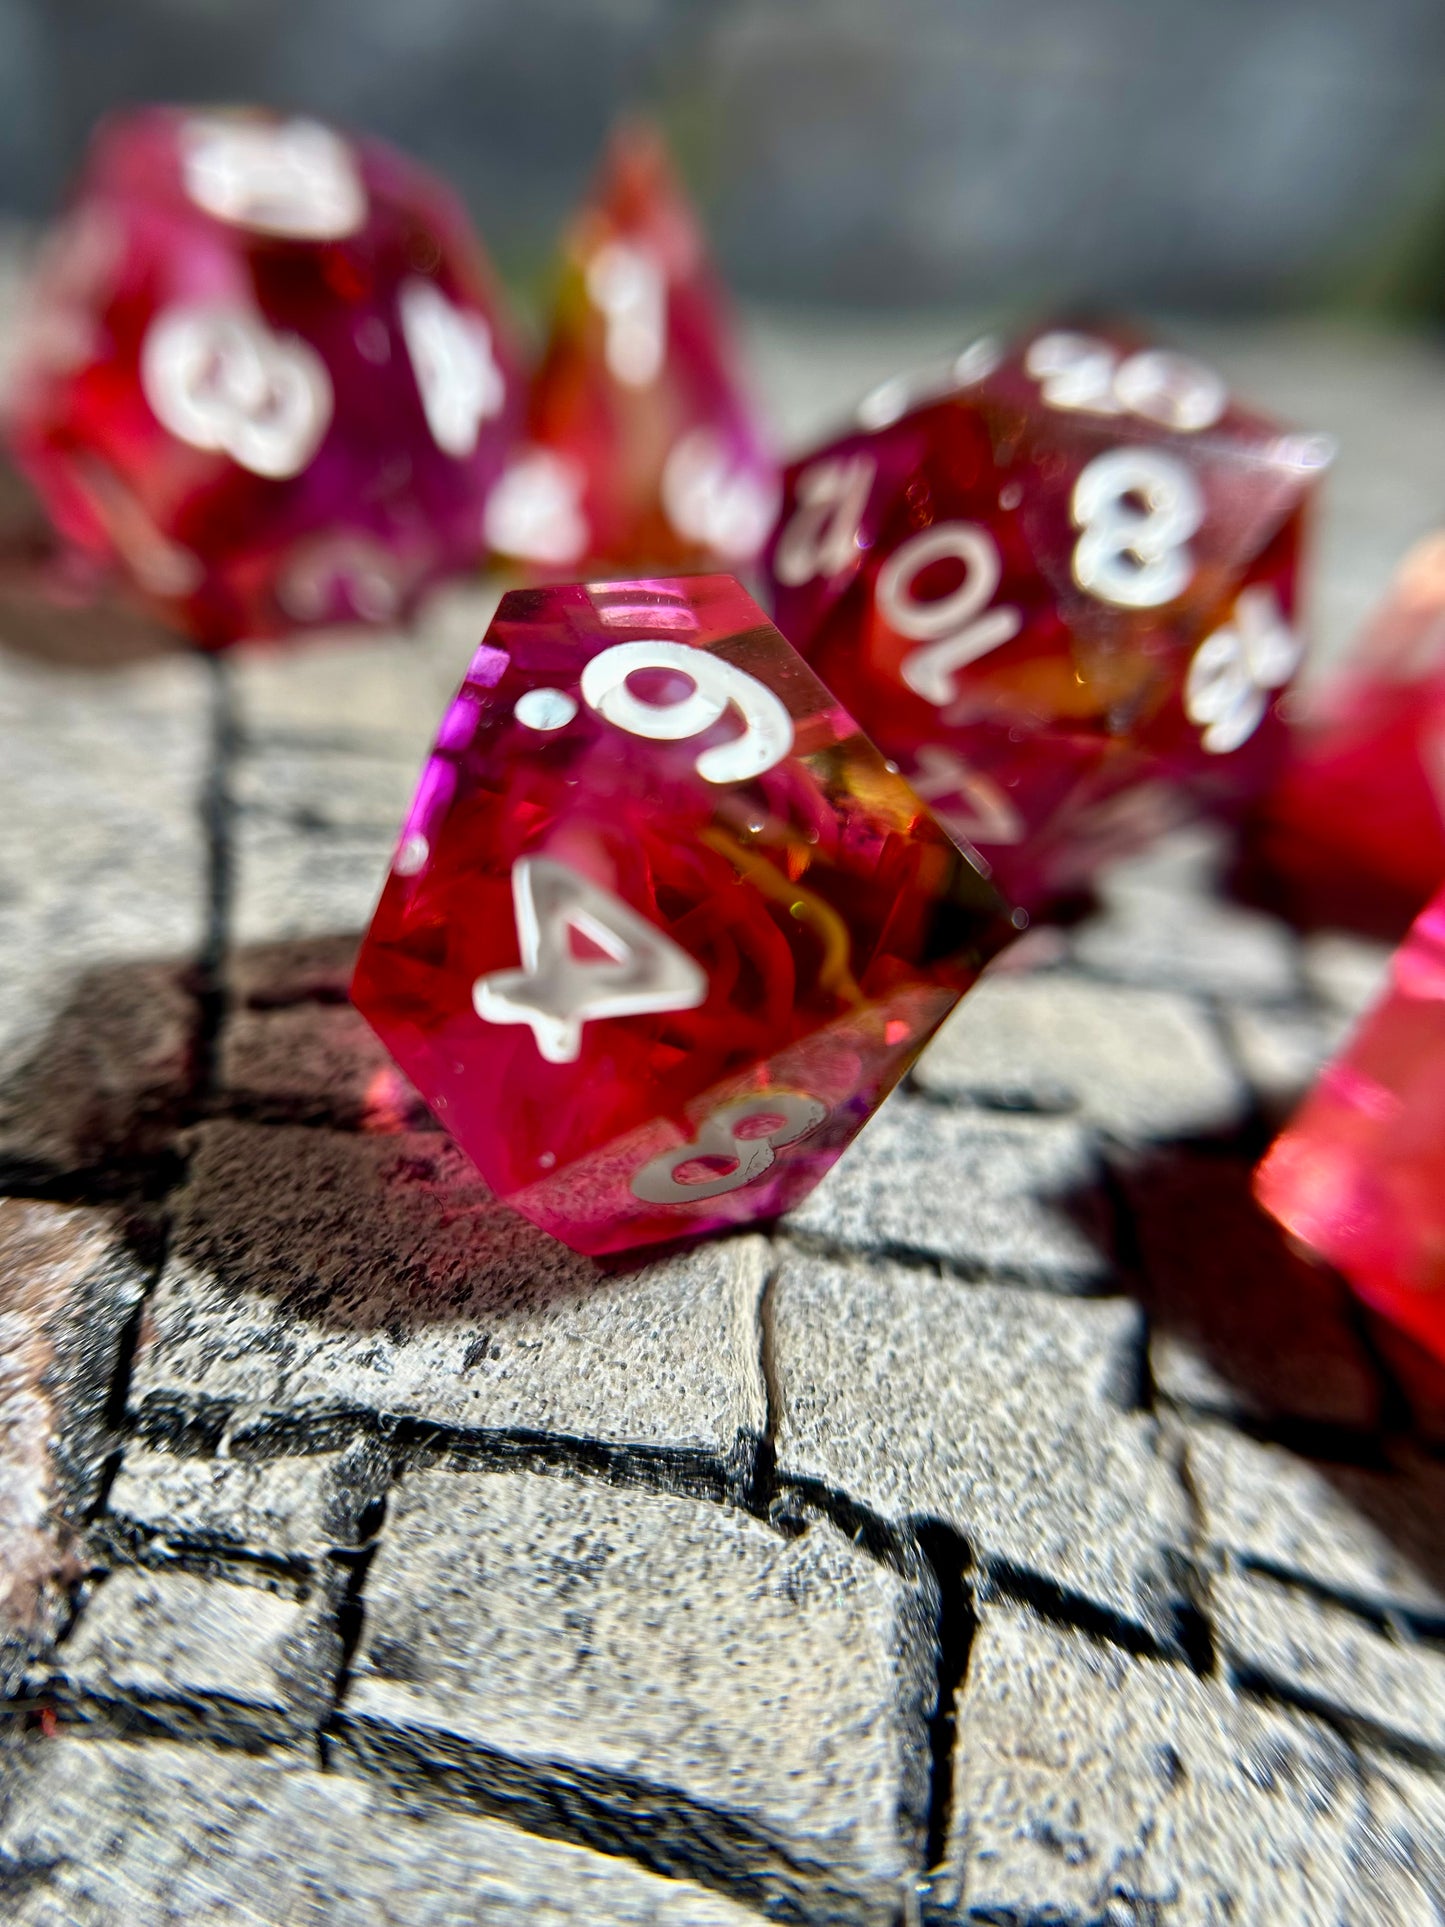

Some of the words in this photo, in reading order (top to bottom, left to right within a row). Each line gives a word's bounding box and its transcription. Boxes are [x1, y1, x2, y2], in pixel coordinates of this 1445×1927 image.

[875, 521, 1021, 706] 10
[1072, 447, 1202, 608] 8
[472, 855, 708, 1064] 4
[629, 1091, 830, 1206] 8
